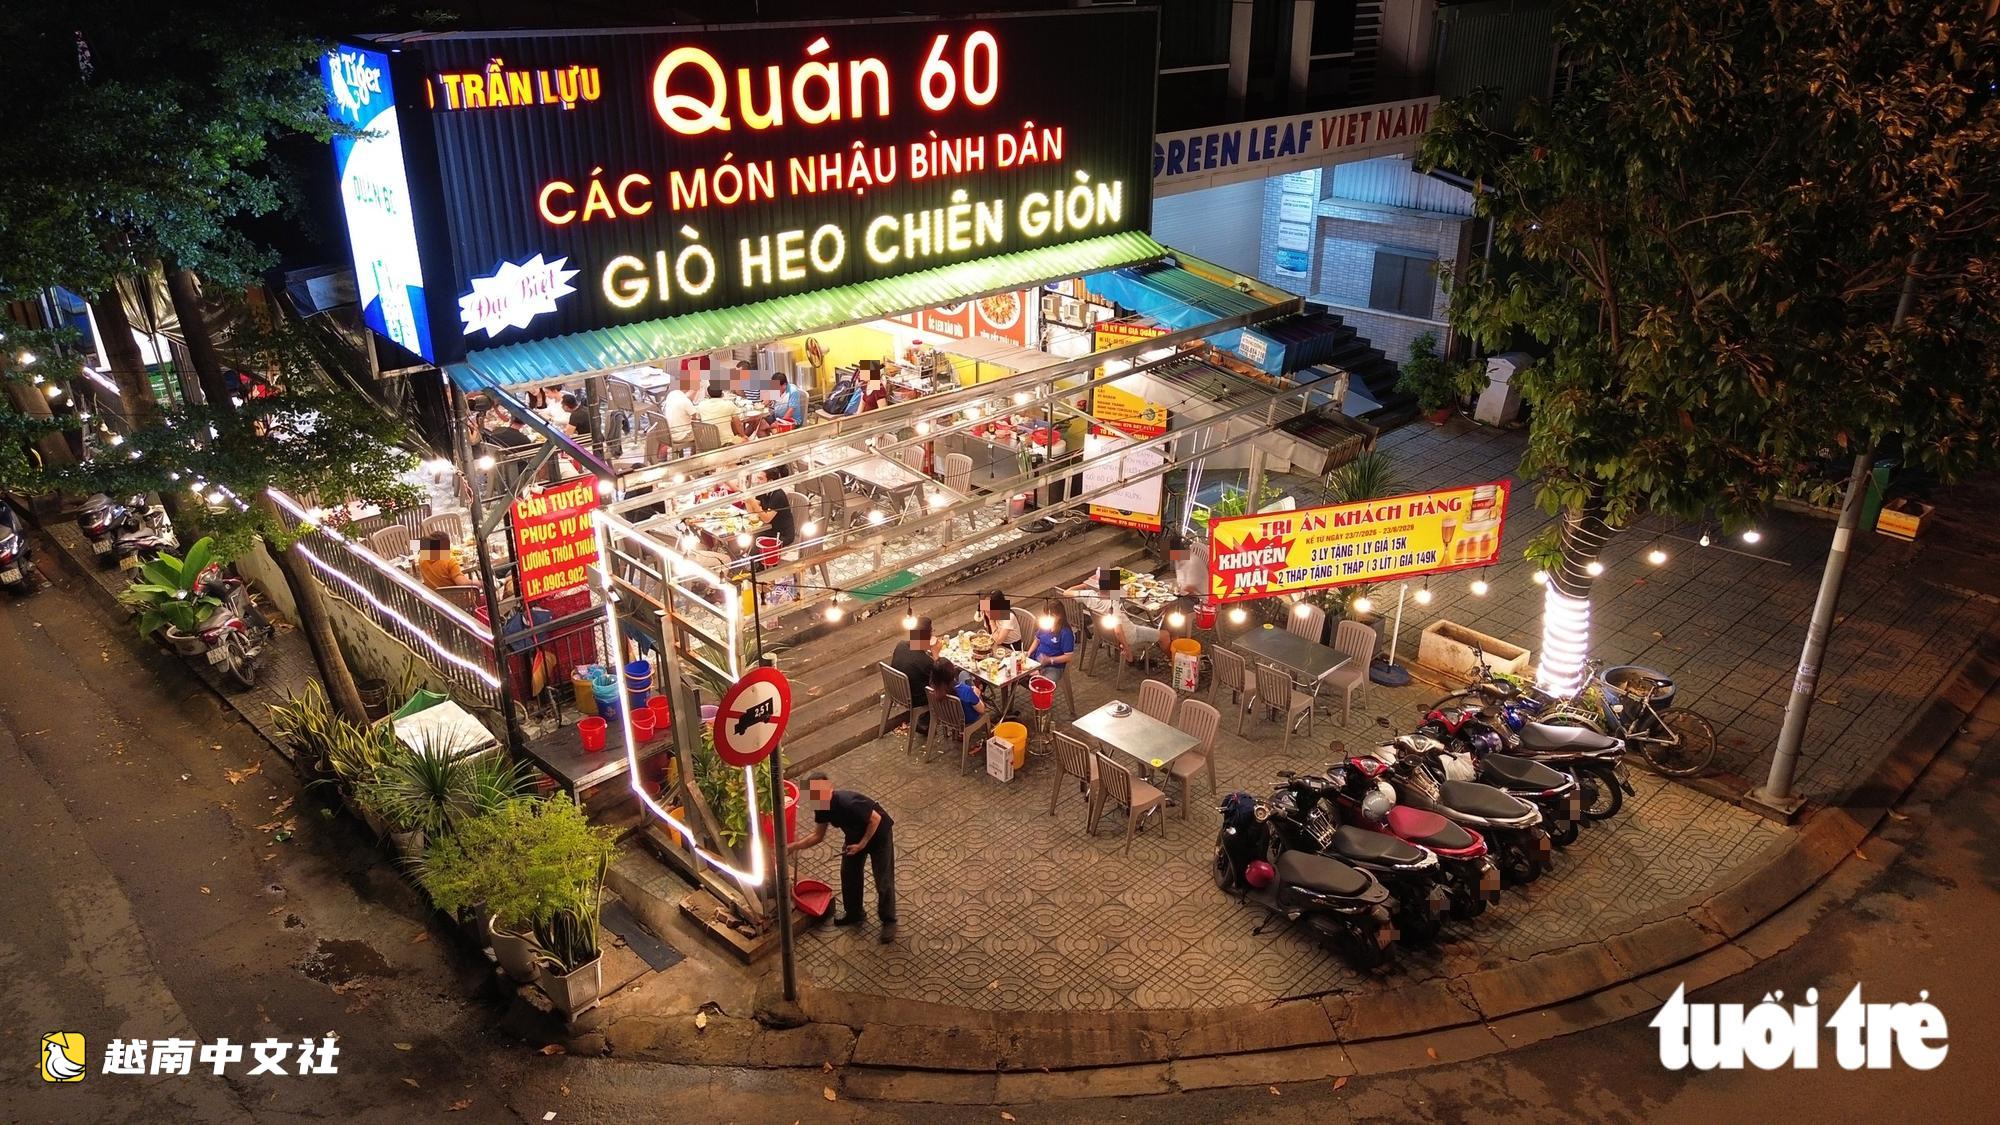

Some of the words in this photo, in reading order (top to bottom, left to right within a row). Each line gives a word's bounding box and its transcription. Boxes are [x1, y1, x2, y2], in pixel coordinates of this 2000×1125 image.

[341, 52, 381, 101] Tiger
[440, 58, 534, 110] TRẦN
[537, 65, 601, 111] LỰU
[653, 36, 890, 135] Quán
[919, 30, 999, 111] 60
[1153, 130, 1241, 178] GREEN
[1248, 120, 1313, 163] LEAF
[1320, 111, 1373, 150] VIET
[1376, 102, 1429, 142] NAM
[538, 166, 653, 225] CÁC
[669, 152, 775, 211] MÓN
[789, 140, 897, 195] NHẬU
[911, 130, 985, 180] BÌNH
[997, 121, 1063, 168] DÂN
[602, 224, 716, 309] GIÒ
[739, 222, 846, 288] HEO
[866, 188, 1004, 264] CHIÊN
[1018, 169, 1123, 237] GIÒN
[549, 482, 594, 511] TUYỂN
[1260, 520, 1292, 537] TRI
[1299, 512, 1327, 532] ÂN
[1334, 503, 1401, 527] KHÁCH
[1408, 496, 1462, 518] HÀNG
[520, 522, 557, 545] PHỤC
[559, 517, 577, 537] VỤ
[1312, 549, 1317, 562] 3
[1319, 547, 1329, 560] LY
[1331, 543, 1353, 561] TẶNG
[1356, 543, 1360, 555] 1
[1363, 541, 1373, 555] LY
[1391, 536, 1407, 550] 15K
[522, 548, 551, 572] LƯƠNG
[552, 541, 574, 562] THỎA
[575, 533, 597, 558] THUẬ
[1219, 543, 1287, 570] KHUYẾN
[1278, 571, 1284, 587] 2
[1335, 564, 1340, 576] 1
[1372, 559, 1378, 571] 3
[1416, 550, 1437, 565] 149K
[1234, 569, 1269, 588] MÃI
